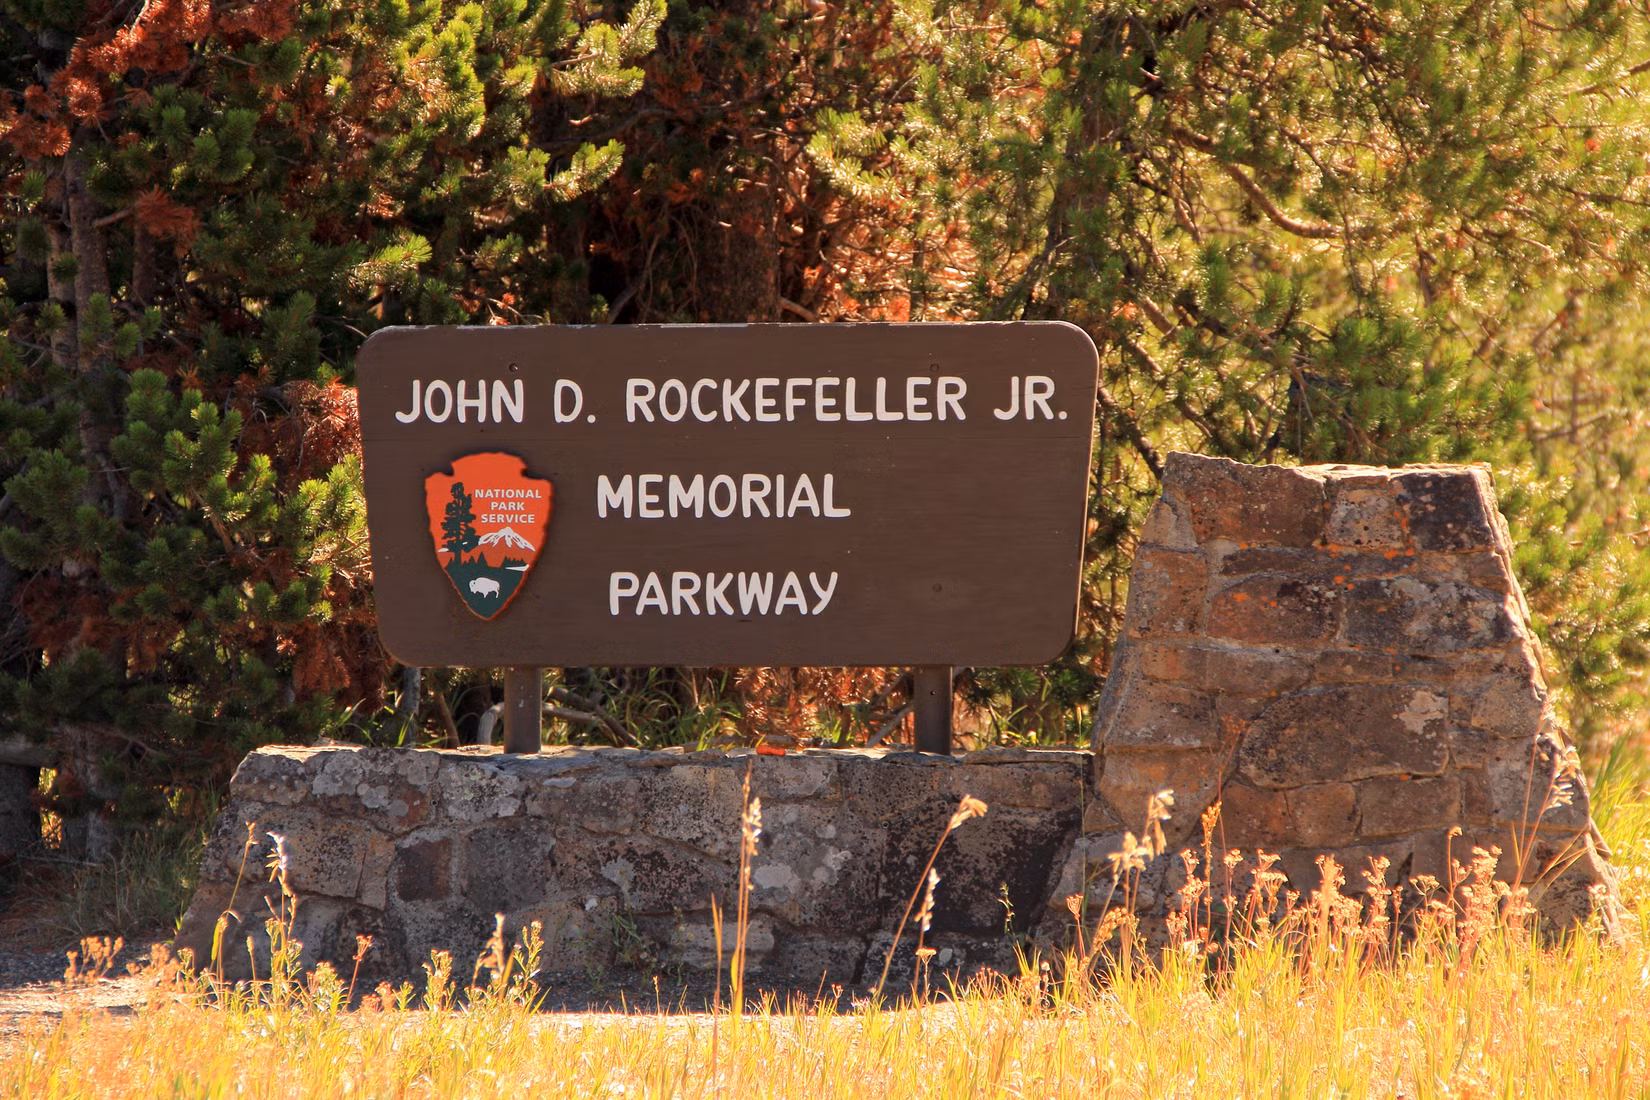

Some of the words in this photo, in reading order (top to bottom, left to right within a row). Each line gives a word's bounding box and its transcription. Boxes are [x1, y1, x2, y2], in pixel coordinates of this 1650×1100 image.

[395, 379, 524, 424] JOHN
[553, 379, 596, 424] D.
[626, 376, 967, 423] ROCKEFELLER
[993, 375, 1068, 421] JR.
[475, 489, 542, 499] NATIONAL
[491, 501, 525, 511] PARK
[597, 473, 851, 519] MEMORIAL
[481, 513, 535, 524] SERVICE
[609, 571, 838, 616] PARKWAY
